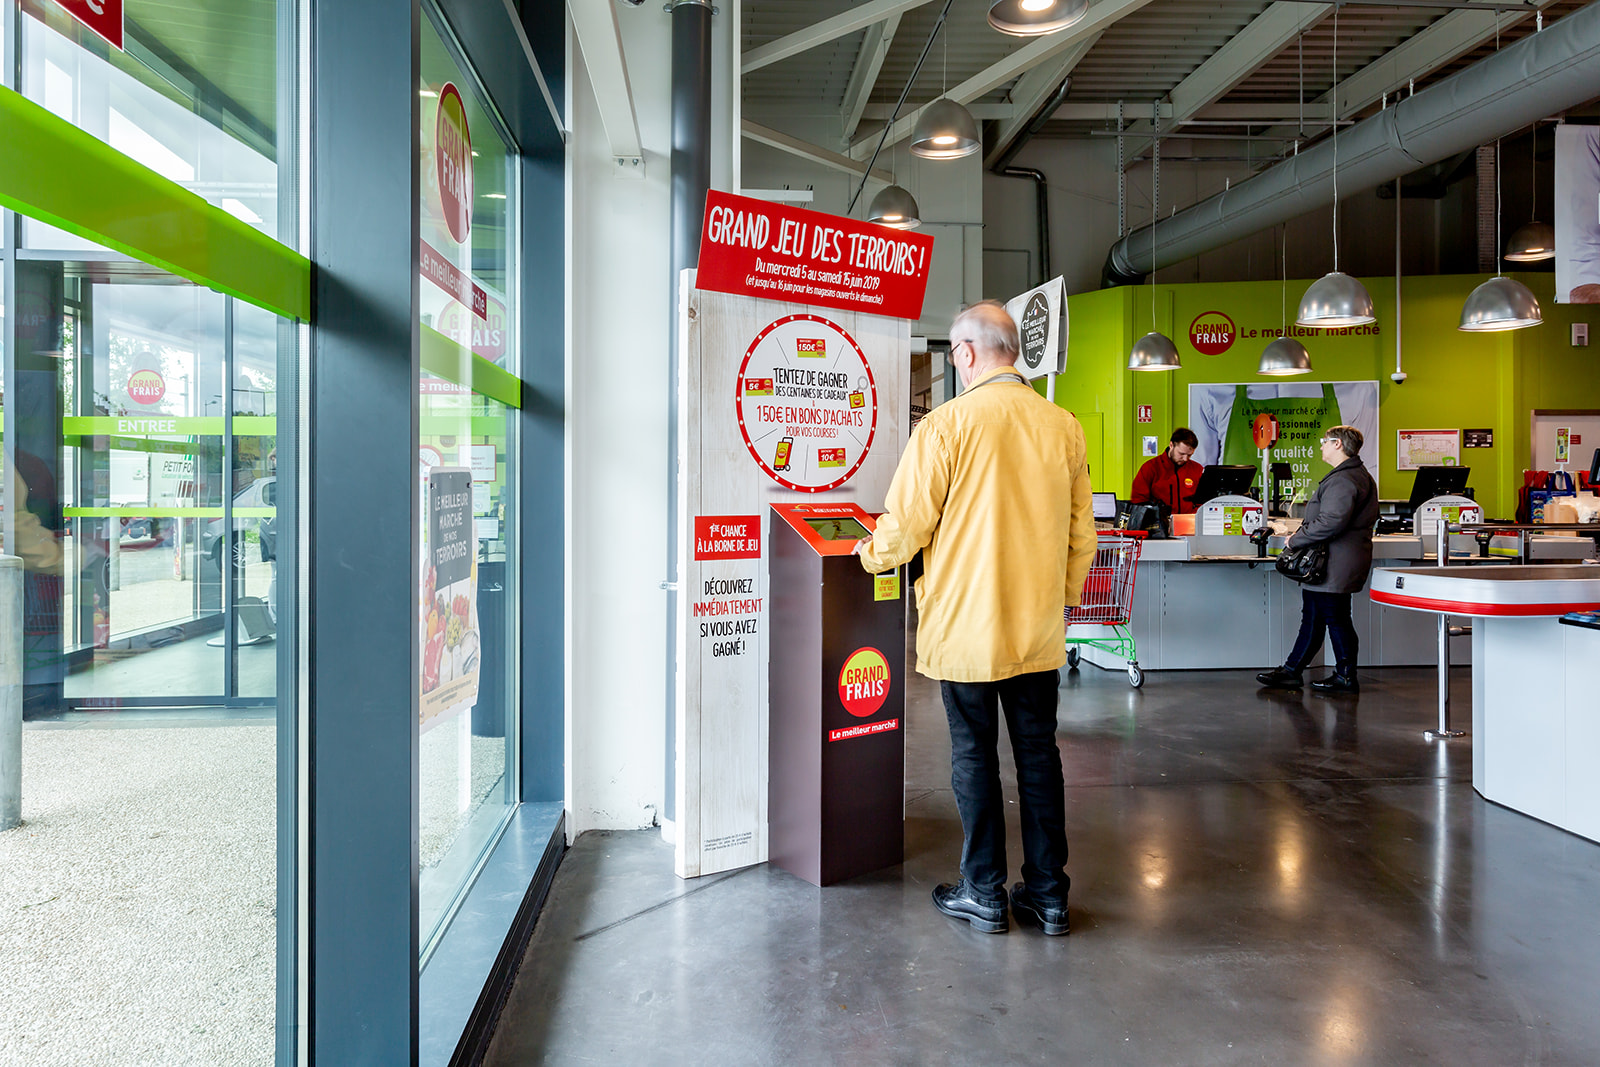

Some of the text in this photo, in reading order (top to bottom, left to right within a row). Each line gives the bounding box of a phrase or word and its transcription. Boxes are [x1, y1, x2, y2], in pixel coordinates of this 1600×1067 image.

[708, 205, 770, 250] GRAND
[771, 217, 807, 258] JEU
[811, 225, 844, 263] DES
[848, 233, 918, 276] TERROIRS
[755, 257, 880, 290] Du mercredi 5 au samedi 15 juin 2019
[746, 274, 756, 286] (et
[782, 281, 793, 292] juin
[792, 284, 805, 294] pour
[1196, 323, 1229, 334] GRAND
[1240, 322, 1380, 338] Le meilleur marché
[1196, 332, 1229, 344] FRAIS
[798, 344, 816, 352] 150€
[132, 379, 160, 388] GRAND
[773, 367, 848, 389] TENTEZ DE GAGNER
[132, 387, 160, 396] FRAIS
[775, 386, 786, 397] DES
[786, 387, 816, 398] CENTAINES
[816, 389, 824, 399] DE
[756, 405, 863, 427] 150€ EN BONS D'ACHATS
[1241, 408, 1249, 416] Le
[1282, 407, 1308, 415] marché
[1310, 407, 1328, 415] c'est
[118, 420, 177, 433] ENTREE
[786, 426, 800, 437] POUR
[800, 426, 812, 438] VOS
[812, 427, 836, 438] COURSES
[1290, 432, 1311, 441] pour
[1273, 445, 1314, 461] qualité
[163, 460, 183, 472] PETIT
[434, 492, 469, 511] LE MEILLEUR
[439, 508, 463, 529] MARCHÉ
[720, 524, 747, 537] CHANCE
[436, 540, 467, 565] TERROIRS
[697, 538, 758, 553] À LA BORNE DE JEU
[704, 577, 753, 596] DÉCOUVREZ
[693, 598, 763, 617] IMMÉDIATEMENT
[700, 619, 757, 638] SI VOUS AVEZ
[712, 637, 741, 657] GAGNÉ
[846, 665, 884, 684] GRAND
[846, 679, 884, 701] FRAIS
[831, 720, 896, 740] Le meilleur marché
